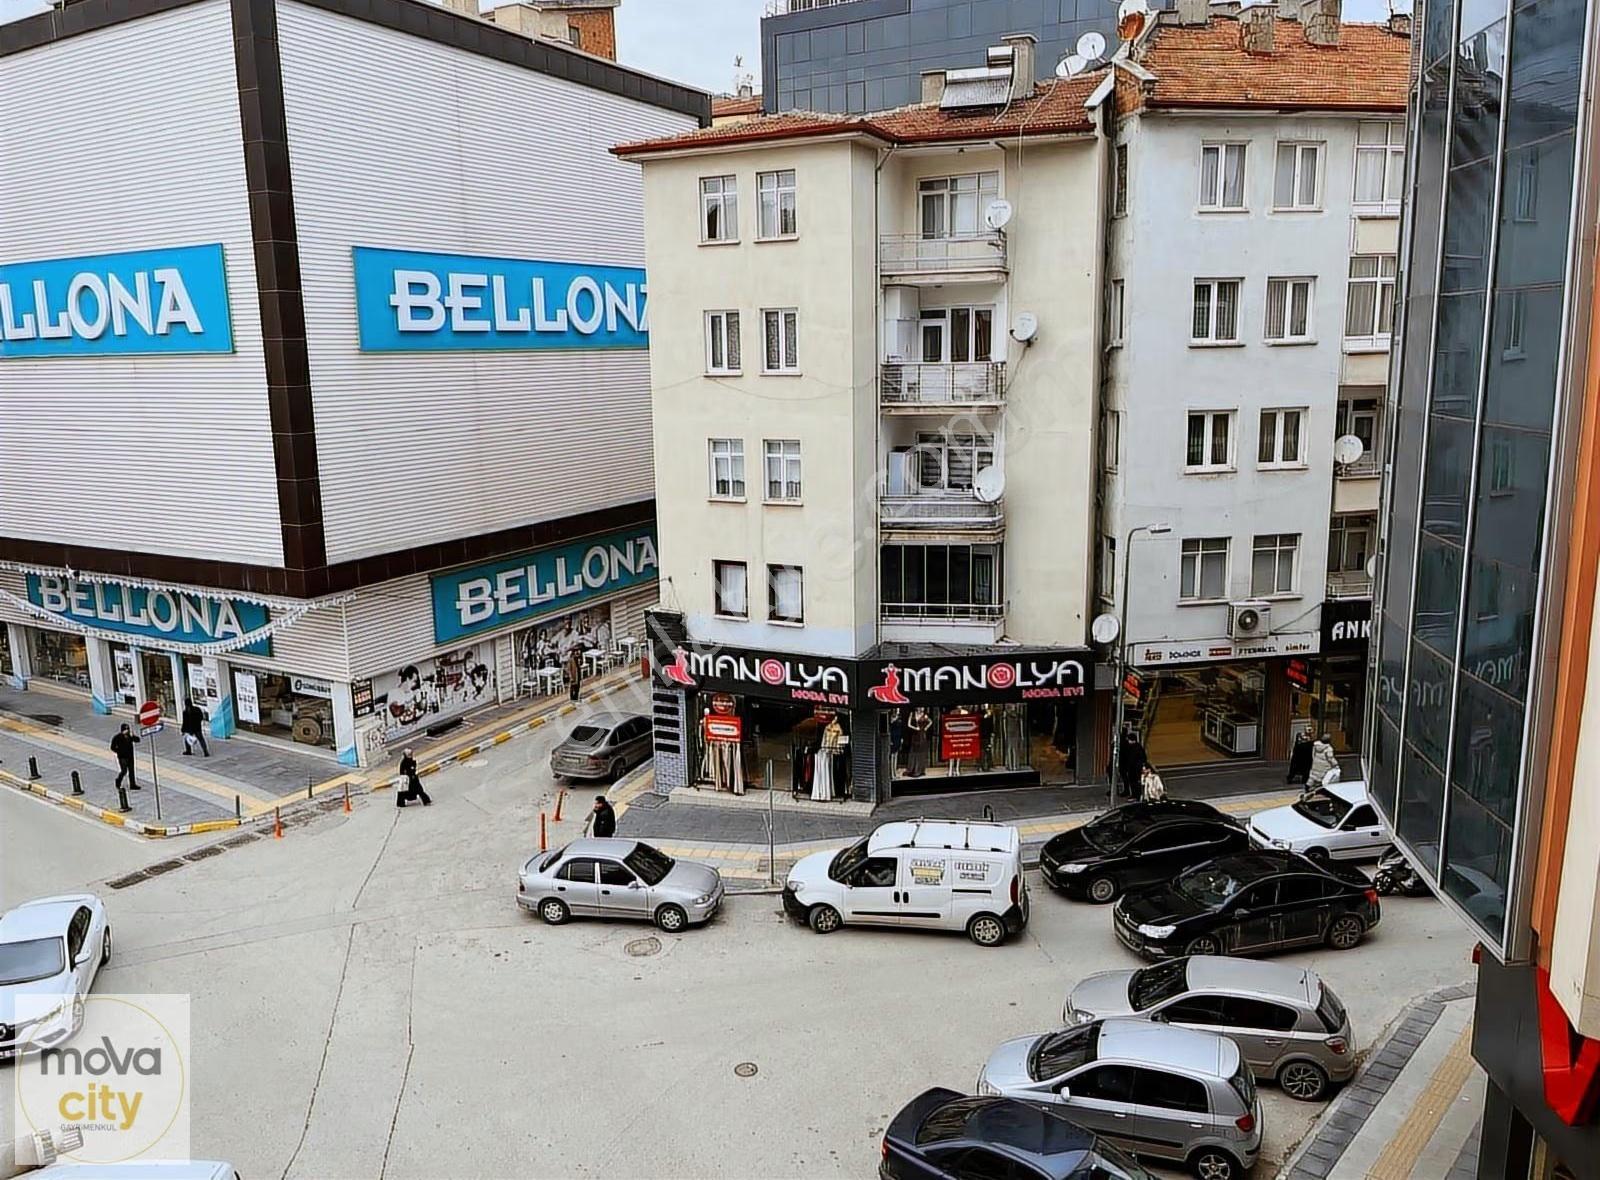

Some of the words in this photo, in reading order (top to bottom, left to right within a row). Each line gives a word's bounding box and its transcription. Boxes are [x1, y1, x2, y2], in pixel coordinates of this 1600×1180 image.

[0, 268, 204, 340] LLONA
[38, 574, 245, 640] BELLONA
[456, 535, 658, 626] BELLONA
[690, 651, 848, 693] MANOLYA
[903, 660, 1084, 692] MANOLYA
